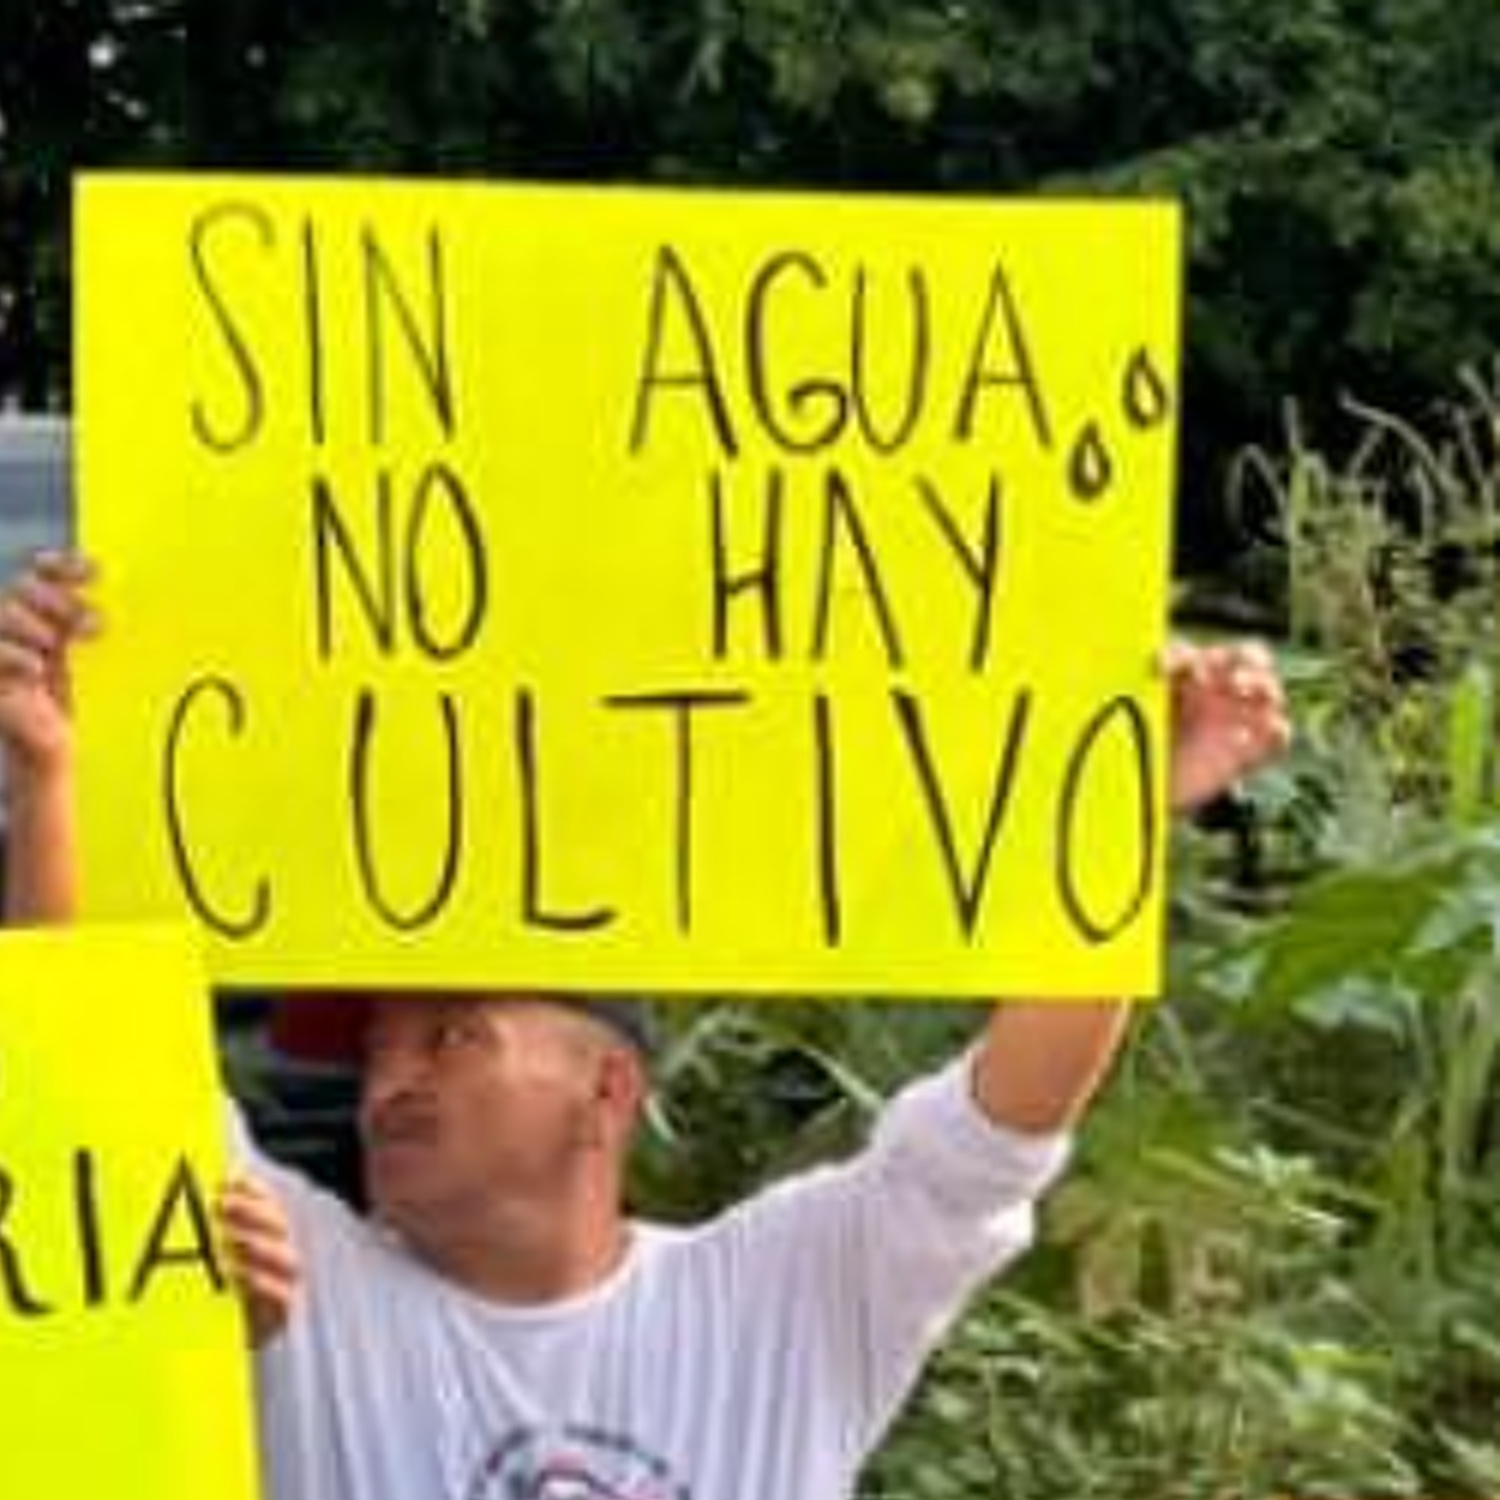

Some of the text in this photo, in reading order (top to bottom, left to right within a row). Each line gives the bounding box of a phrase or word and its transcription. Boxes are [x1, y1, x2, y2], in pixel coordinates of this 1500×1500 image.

[188, 203, 1053, 462] SIN AGUA
[310, 463, 1002, 674] NO HAY
[162, 676, 1157, 949] CULTIVO
